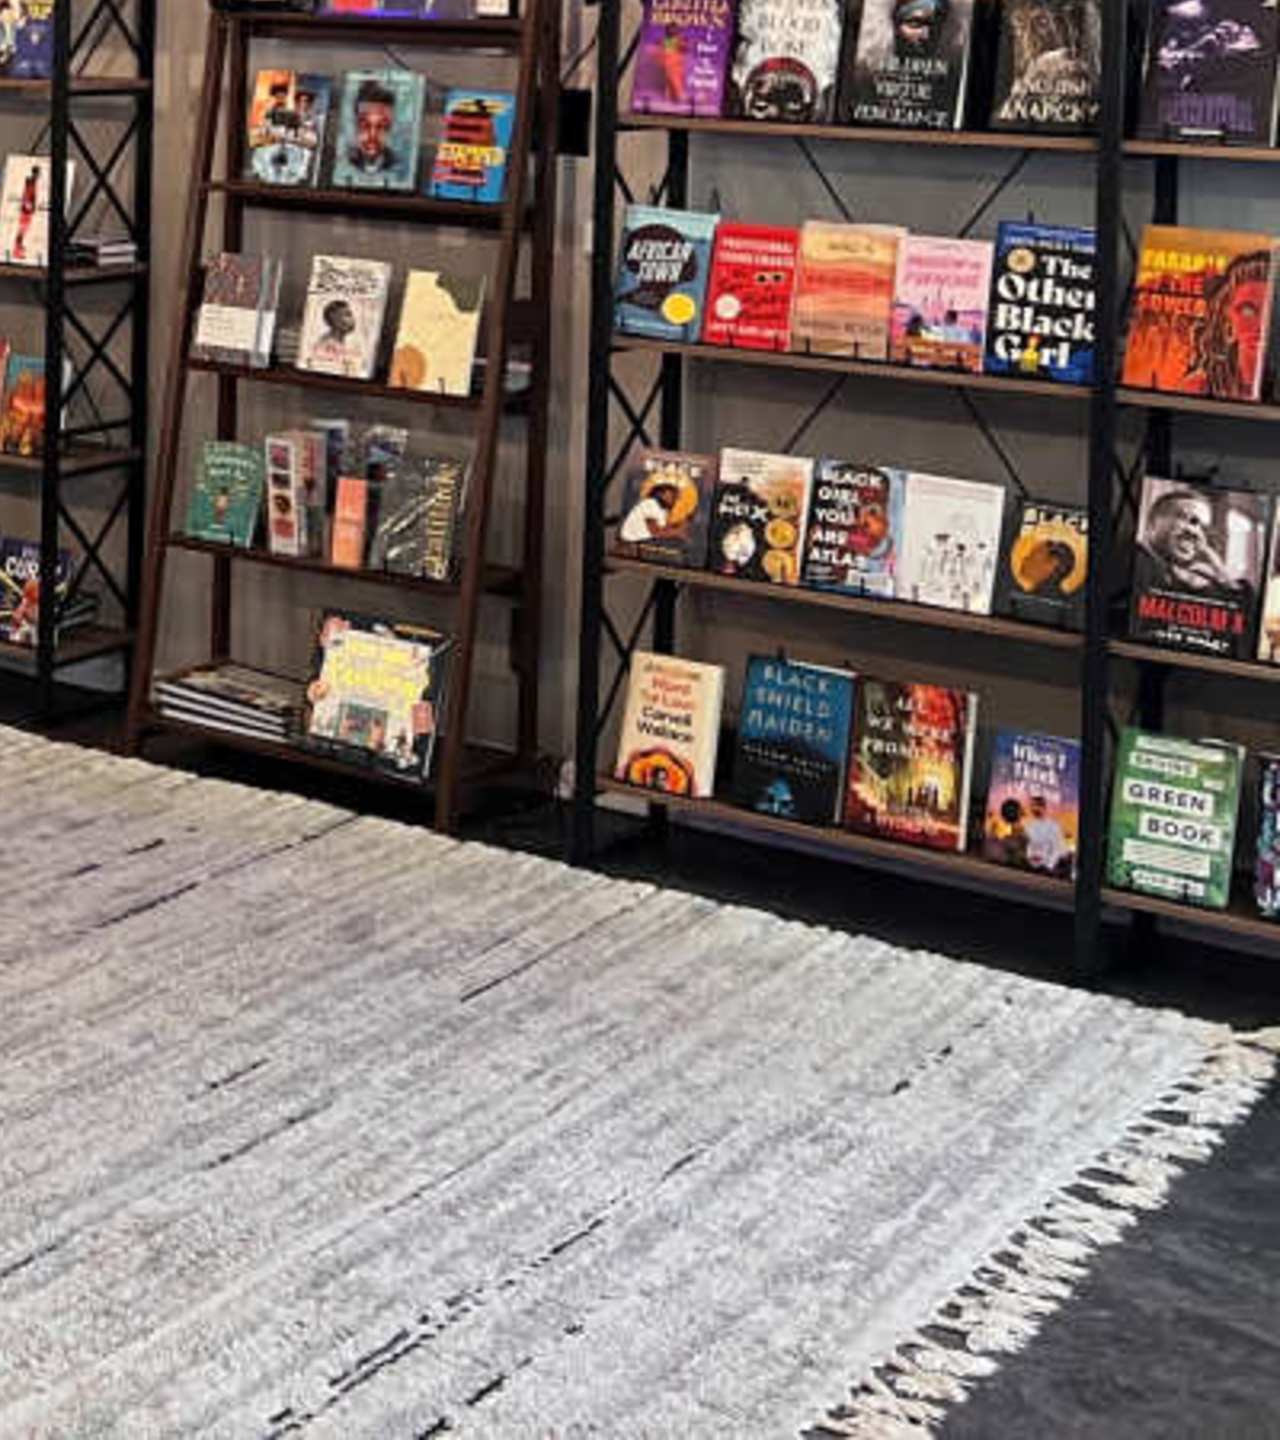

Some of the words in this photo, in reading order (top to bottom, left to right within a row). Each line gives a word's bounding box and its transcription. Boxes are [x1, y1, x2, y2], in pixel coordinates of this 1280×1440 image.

[627, 240, 695, 261] AFRICAN
[637, 261, 683, 283] TOWN
[1042, 255, 1092, 280] The
[994, 303, 1096, 342] Black
[821, 468, 884, 490] BLACK
[764, 665, 832, 693] BLACK
[755, 687, 832, 718] SHIELD
[747, 709, 833, 742] MAIDEN
[1129, 783, 1206, 812] GREEN
[1147, 818, 1215, 844] BOOK
